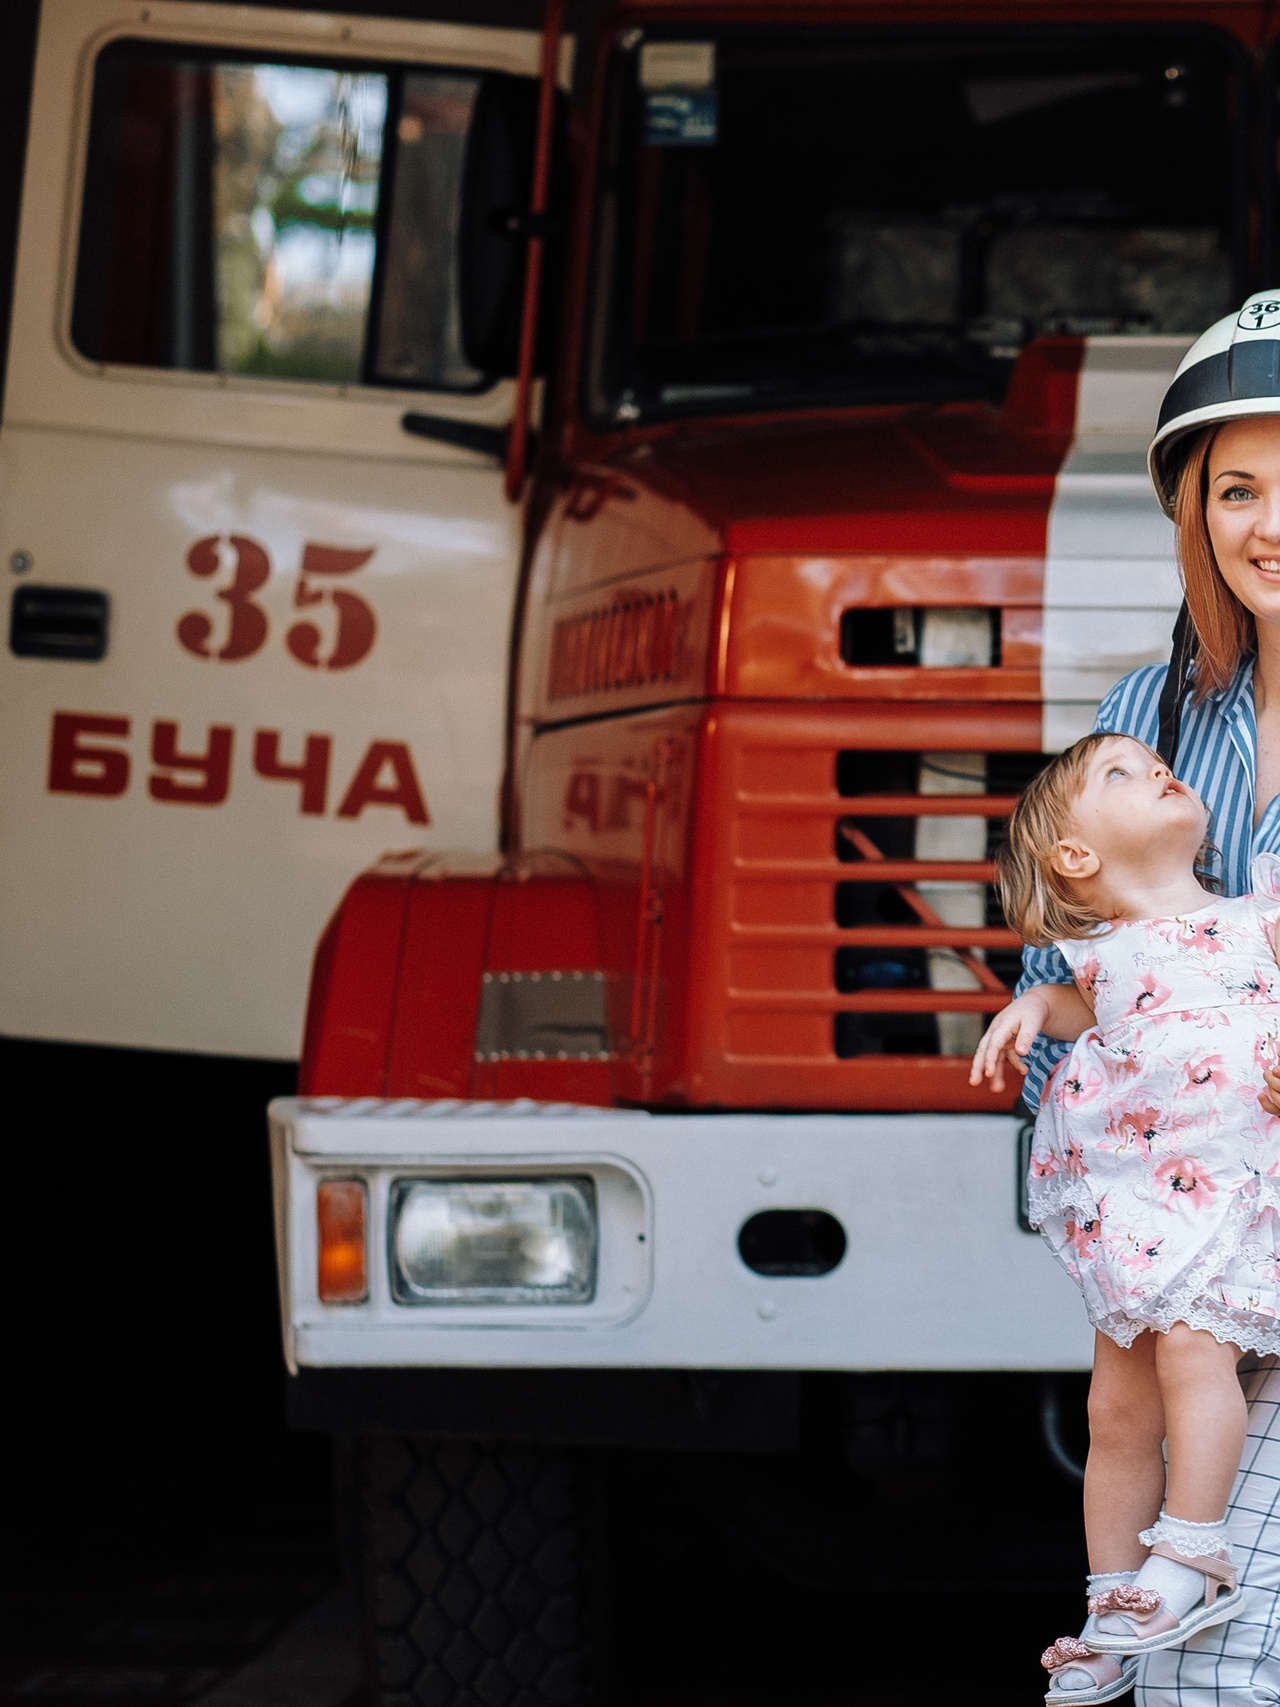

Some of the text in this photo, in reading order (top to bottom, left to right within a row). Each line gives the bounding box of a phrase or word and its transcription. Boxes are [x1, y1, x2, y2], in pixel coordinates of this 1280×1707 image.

[1249, 302, 1280, 314] 36
[1254, 313, 1264, 328] 1
[176, 533, 378, 671] 35
[47, 711, 432, 827] БУЧА
